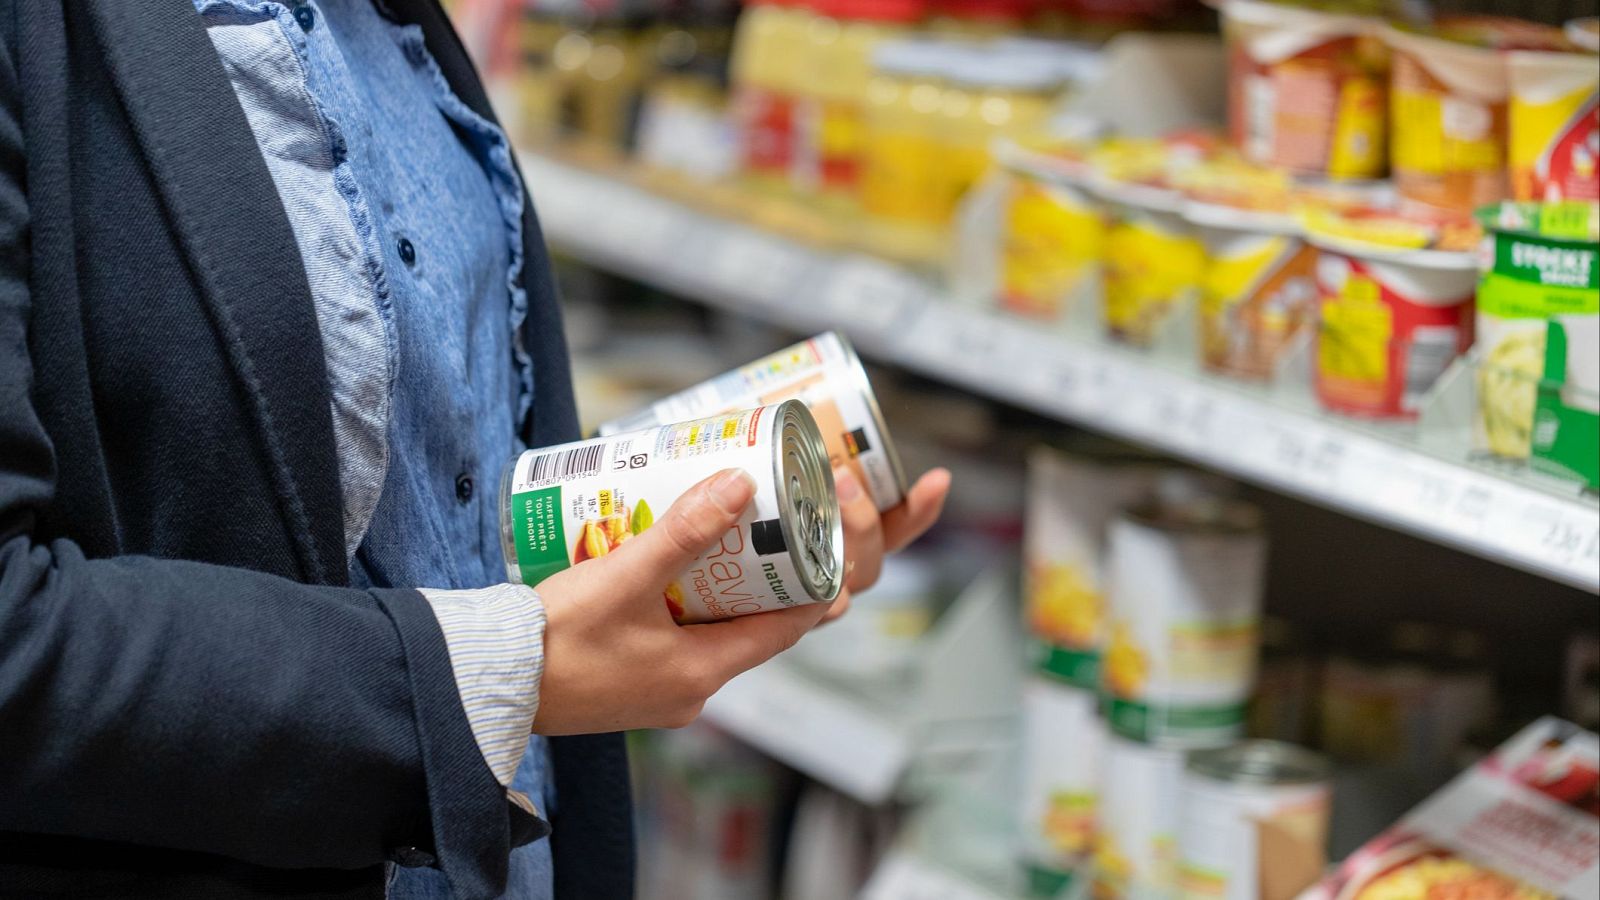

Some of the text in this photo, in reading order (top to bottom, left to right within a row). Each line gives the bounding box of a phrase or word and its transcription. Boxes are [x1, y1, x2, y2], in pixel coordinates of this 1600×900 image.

[528, 477, 561, 488] 610807
[565, 471, 598, 482] 091540
[545, 496, 555, 541] FIXFERTIG
[599, 492, 610, 507] 376
[526, 518, 537, 550] PRONTI
[535, 498, 548, 551] TOUT PRÊTS
[706, 525, 765, 614] Ravio
